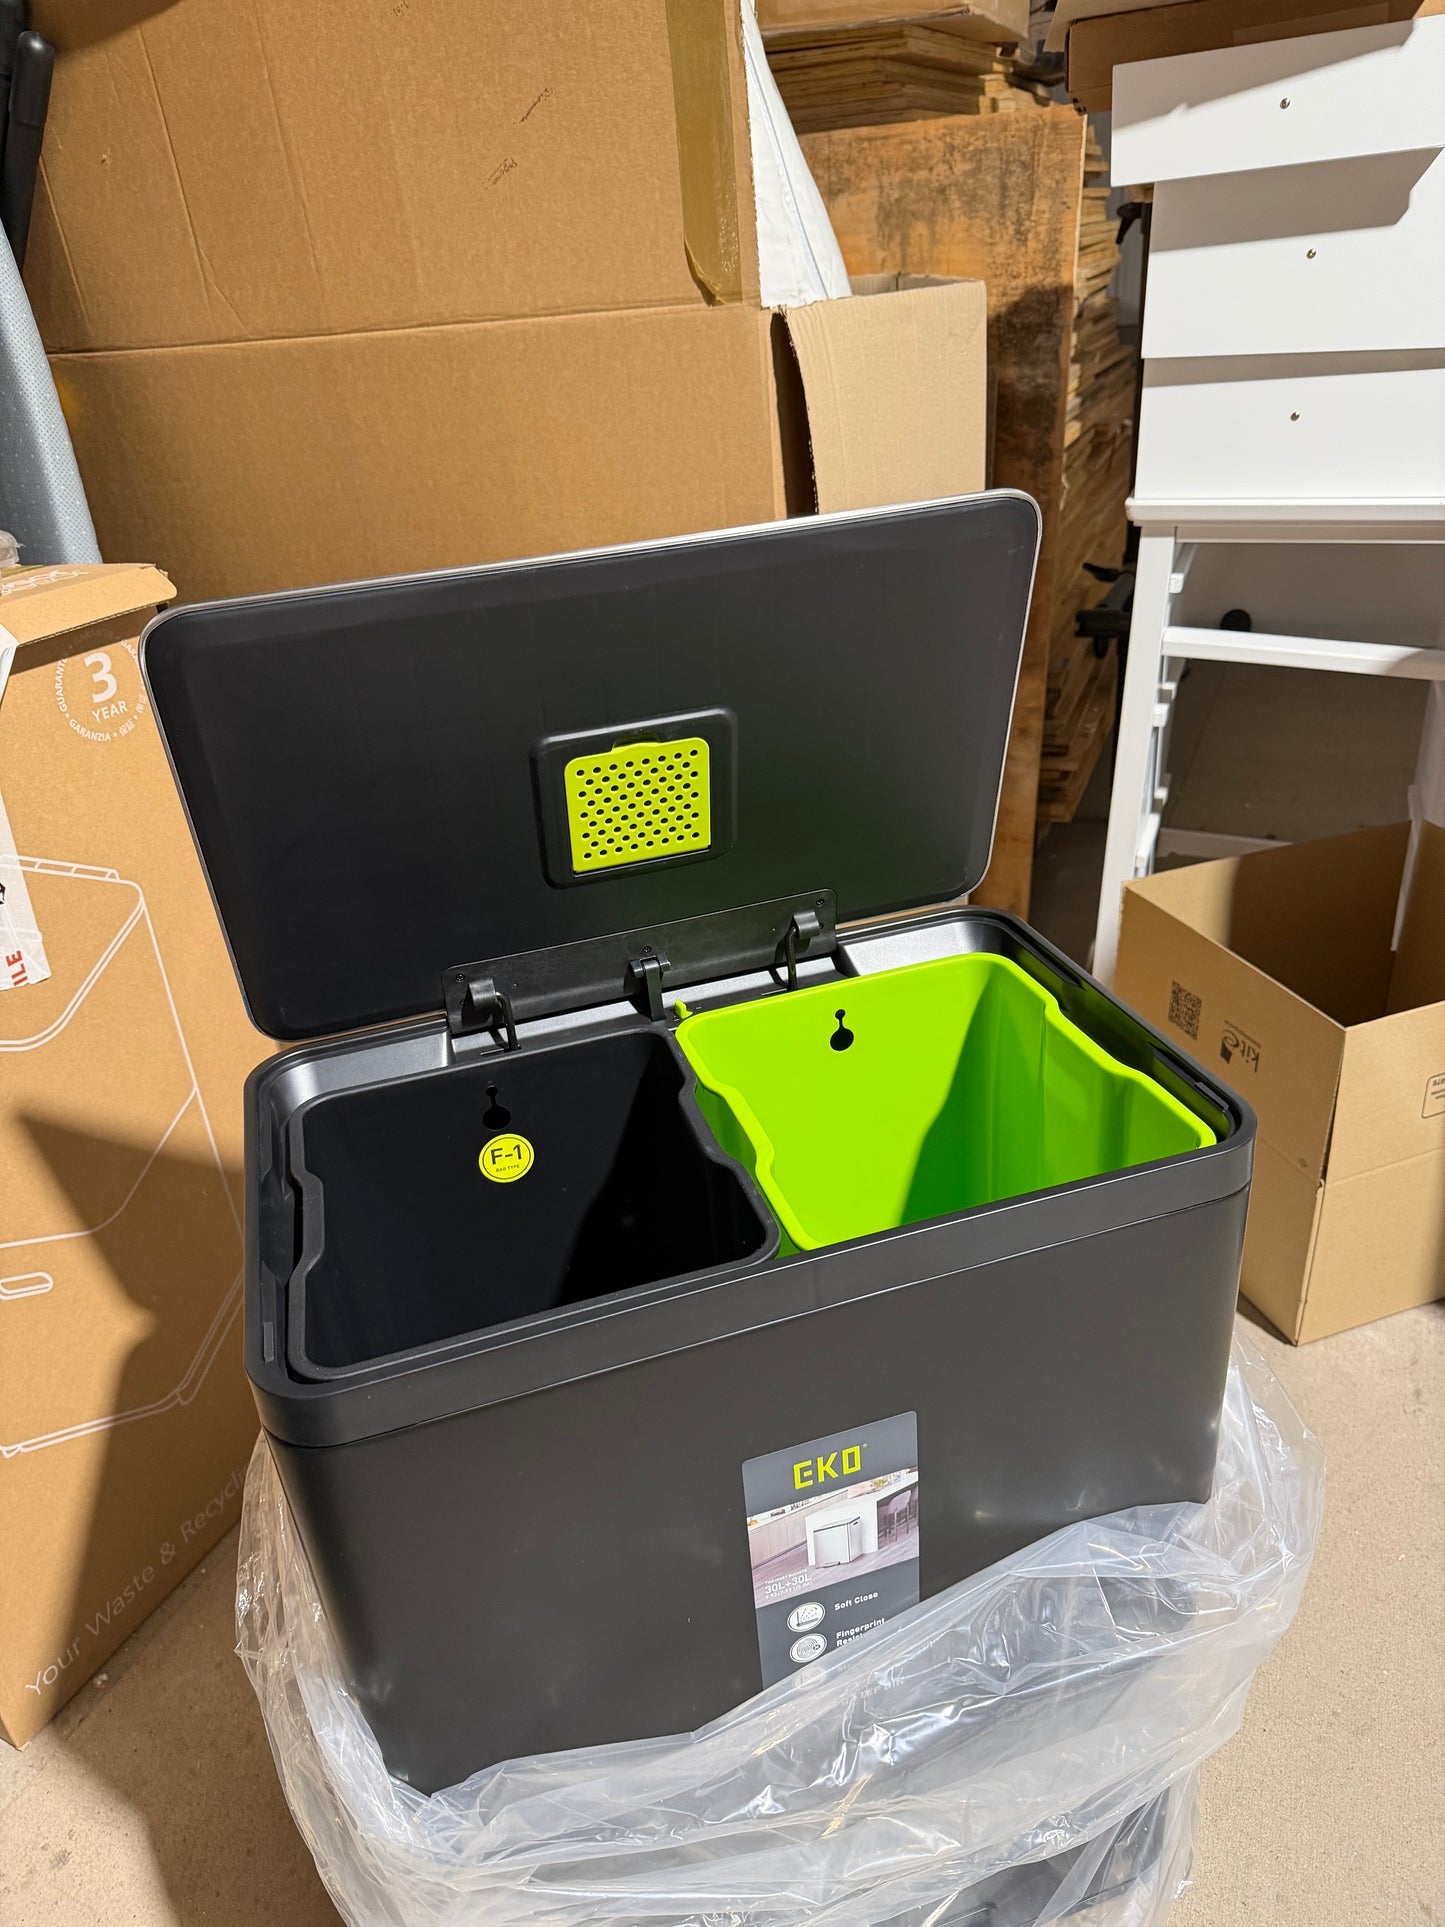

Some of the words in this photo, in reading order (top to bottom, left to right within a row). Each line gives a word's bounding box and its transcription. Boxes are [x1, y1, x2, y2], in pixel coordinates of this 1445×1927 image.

[55, 656, 68, 712] GUARANTE
[84, 652, 117, 703] 3
[92, 700, 128, 722] YEAR
[69, 719, 112, 741] GARANZIA
[5, 950, 28, 986] ILE
[490, 1144, 522, 1165] F-1
[793, 1445, 862, 1490] EKO
[25, 1637, 80, 1695] Your
[85, 1565, 156, 1637] Waste
[159, 1541, 177, 1566] &
[179, 1464, 249, 1544] Recycli
[765, 1573, 813, 1594] 30L+30L
[834, 1599, 853, 1611] Soft
[854, 1591, 879, 1604] Close
[836, 1617, 885, 1639] Fingerprint
